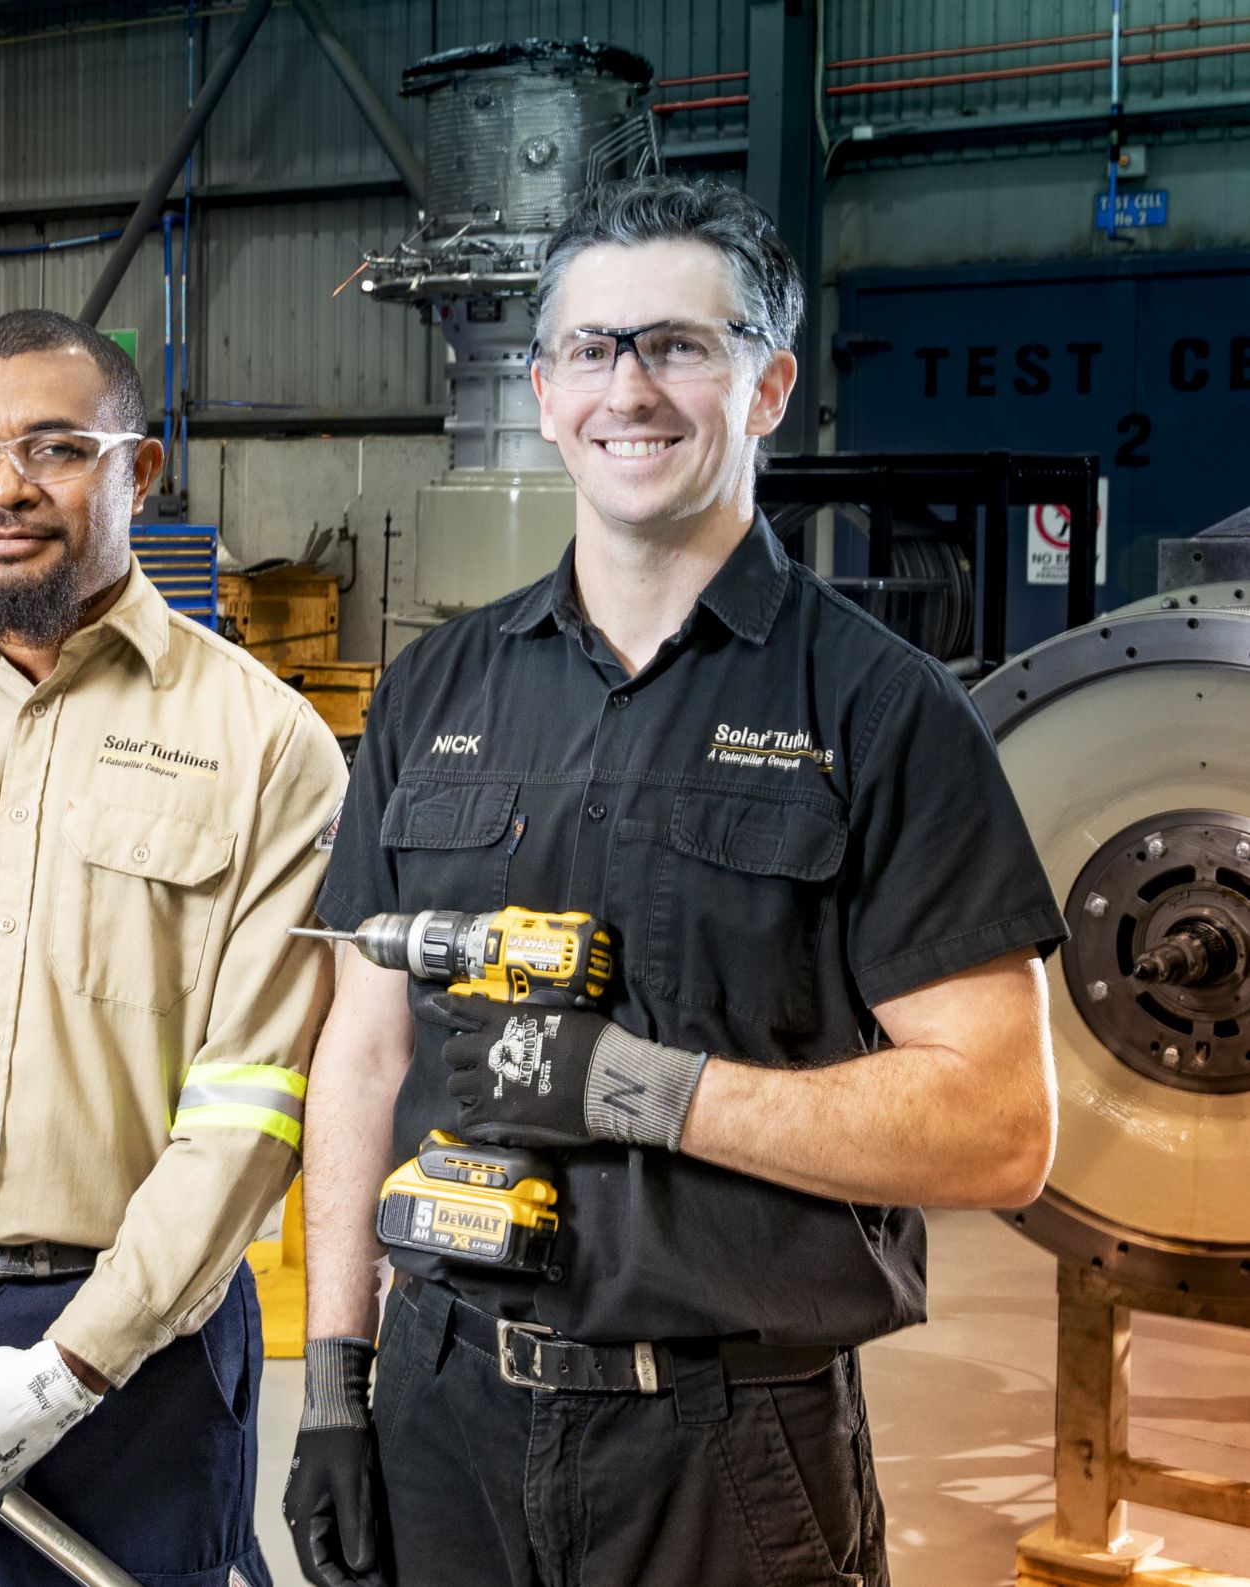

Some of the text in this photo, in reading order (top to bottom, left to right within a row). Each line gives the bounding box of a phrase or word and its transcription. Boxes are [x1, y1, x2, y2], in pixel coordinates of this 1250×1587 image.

[1100, 192, 1161, 211] TST CELL
[1138, 210, 1147, 226] 2
[915, 341, 1103, 398] TEST
[1114, 412, 1151, 468] 2
[1032, 552, 1052, 565] NO
[431, 735, 481, 755] NICK
[714, 724, 772, 748] Solar
[104, 734, 220, 771] Solar Turbines
[707, 748, 716, 761] A
[719, 750, 765, 769] Caterpillar
[97, 755, 180, 779] A Caterpillar Company
[519, 1018, 538, 1088] KOMODO
[416, 1200, 434, 1228] 5
[413, 1228, 497, 1251] AH 18V XR LI-ION
[27, 1381, 53, 1411] Ansell
